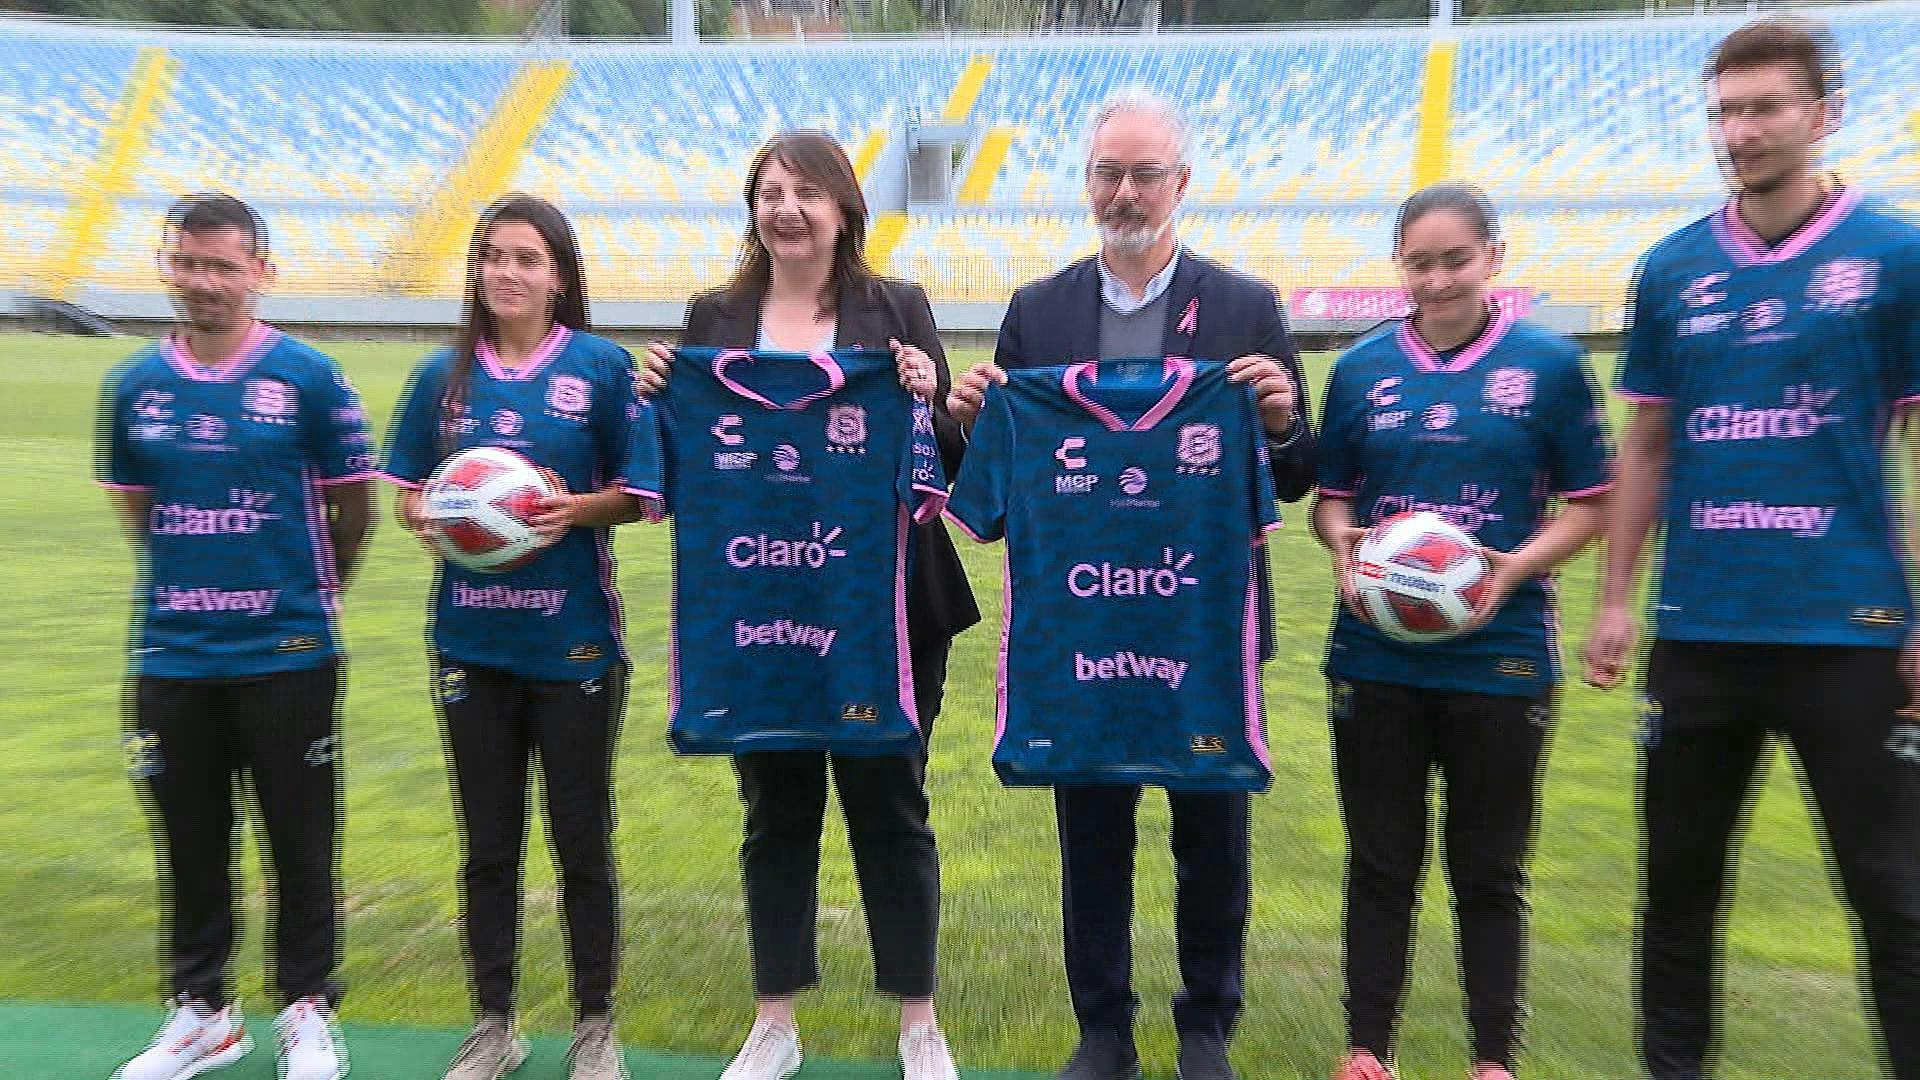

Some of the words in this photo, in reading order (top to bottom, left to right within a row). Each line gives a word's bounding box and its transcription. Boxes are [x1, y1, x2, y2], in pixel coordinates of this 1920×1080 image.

[1686, 392, 1832, 442] Claro
[1055, 474, 1099, 490] MCP
[150, 495, 273, 534] Claro
[1689, 501, 1836, 538] betway
[726, 526, 838, 568] Claro
[1067, 553, 1189, 598] Claro
[156, 586, 281, 617] betway
[452, 582, 568, 616] betway
[734, 619, 838, 657] betway
[1075, 651, 1189, 690] betway
